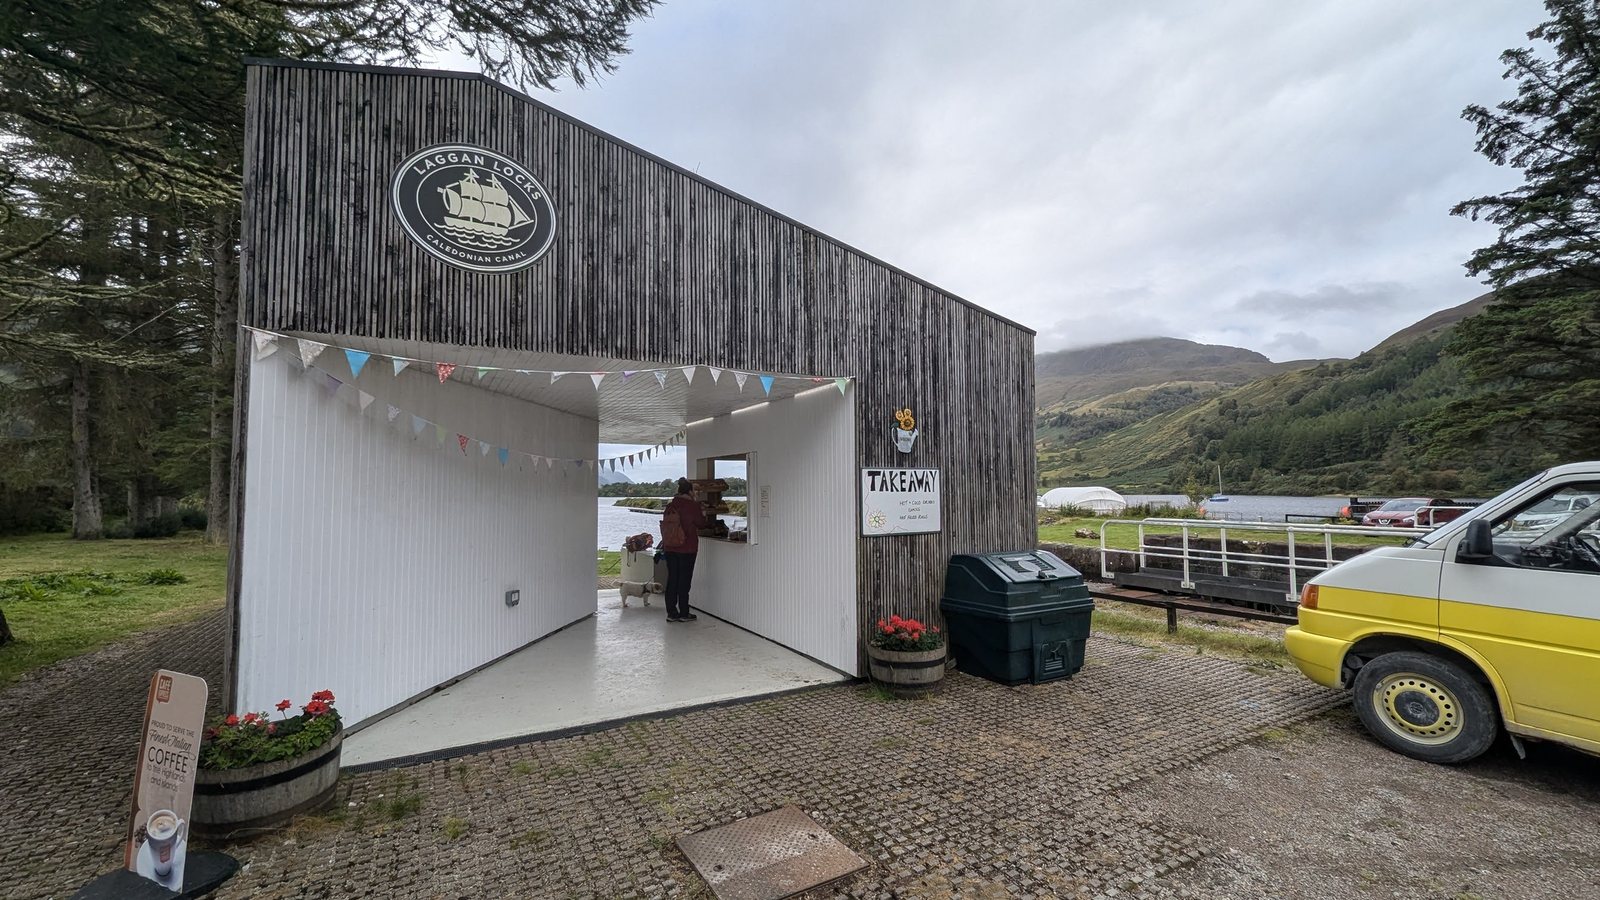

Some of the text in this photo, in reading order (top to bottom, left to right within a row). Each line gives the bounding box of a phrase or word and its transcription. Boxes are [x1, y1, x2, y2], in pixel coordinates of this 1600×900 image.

[413, 153, 542, 200] LAGGAN LOCKS
[426, 234, 527, 263] CALEDONIAN CANAL
[867, 470, 938, 493] TAKEAWAY
[151, 719, 195, 738] PROUD TO SERVE THE
[148, 746, 189, 774] COFFEE
